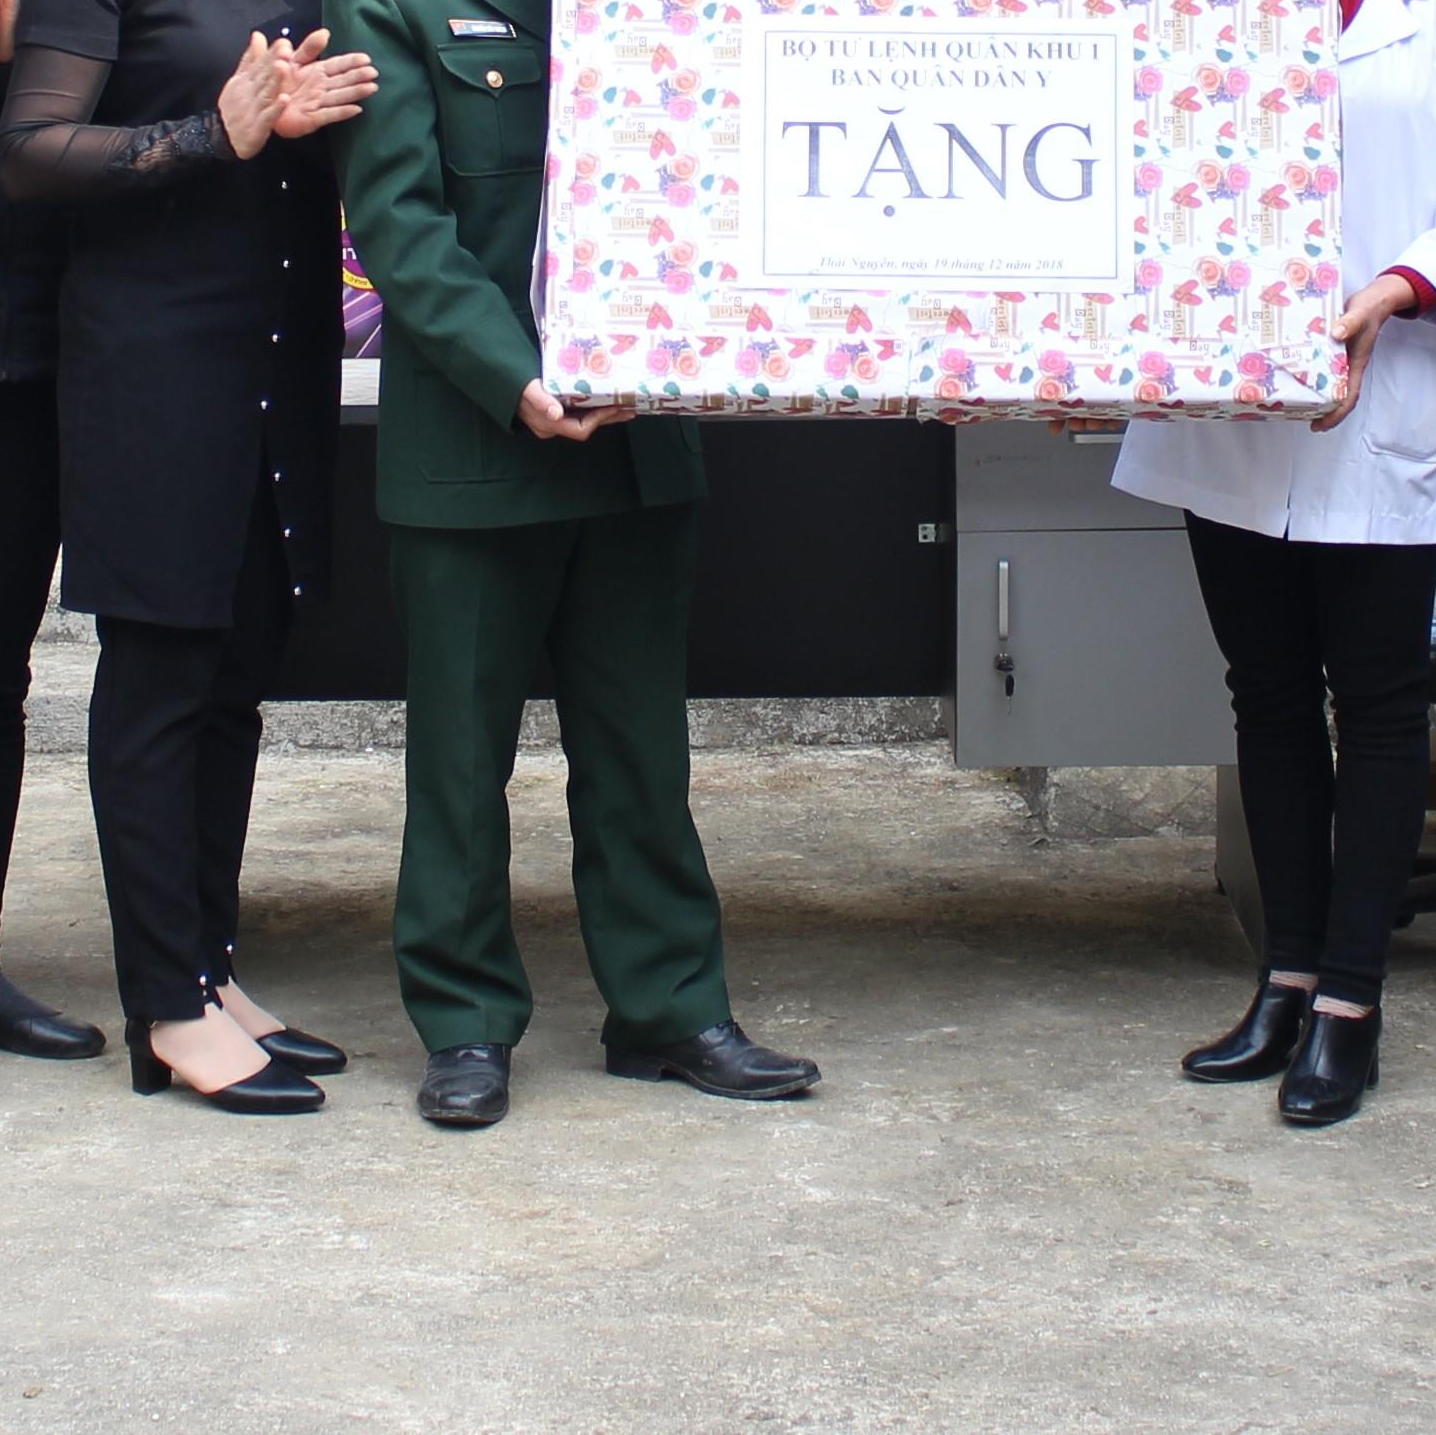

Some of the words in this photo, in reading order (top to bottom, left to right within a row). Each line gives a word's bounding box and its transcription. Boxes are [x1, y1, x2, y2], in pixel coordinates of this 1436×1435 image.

[781, 38, 817, 62] BỘ
[868, 38, 938, 63] LỆNH
[945, 36, 1018, 63] QUÂN
[1027, 41, 1083, 61] KHU
[831, 67, 883, 87] BAN
[890, 64, 965, 91] QUÂN
[973, 64, 1027, 89] DÂN
[1032, 69, 1052, 88] Y
[781, 105, 1102, 218] TẶNG
